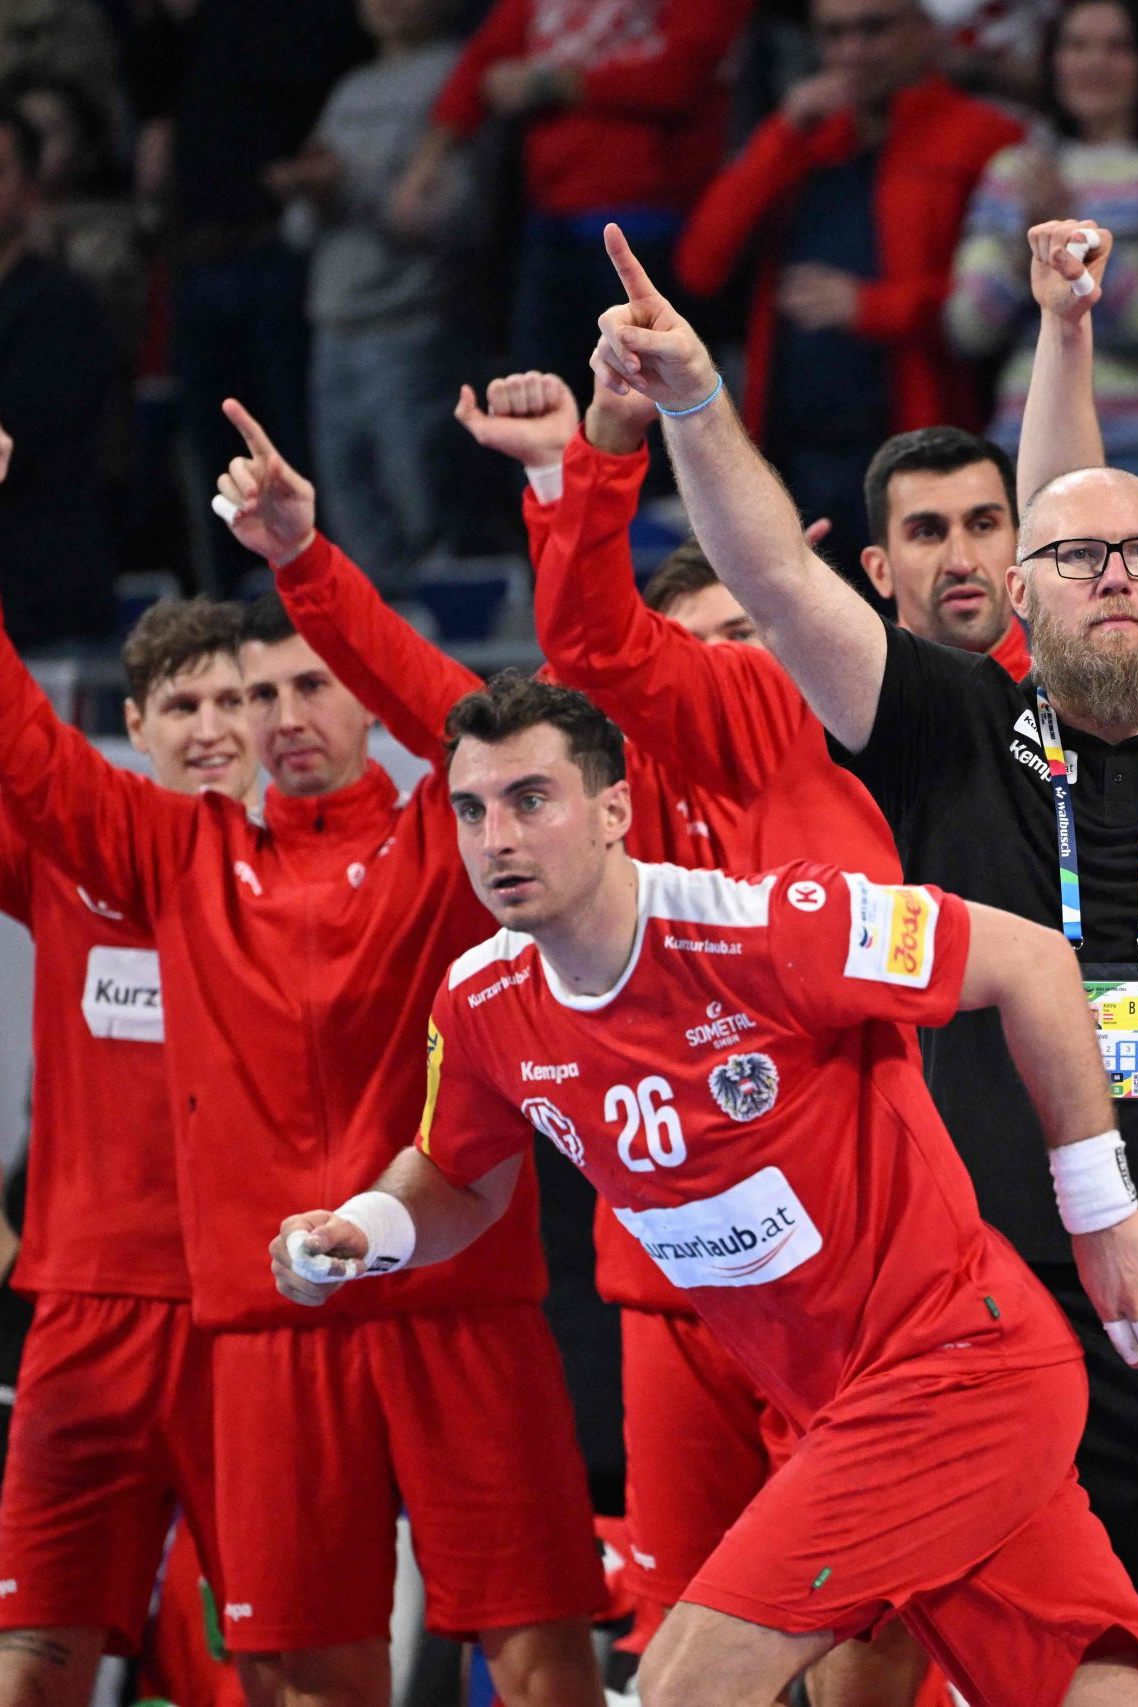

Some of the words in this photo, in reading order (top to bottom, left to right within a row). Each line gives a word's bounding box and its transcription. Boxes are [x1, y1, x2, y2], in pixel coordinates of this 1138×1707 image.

[1057, 801, 1071, 858] walbusch
[685, 1012, 757, 1048] SOMETAL
[1129, 1001, 1136, 1015] B
[520, 1061, 580, 1084] Kempa
[604, 1075, 687, 1172] 26
[637, 1206, 796, 1260] urzurlaub.at
